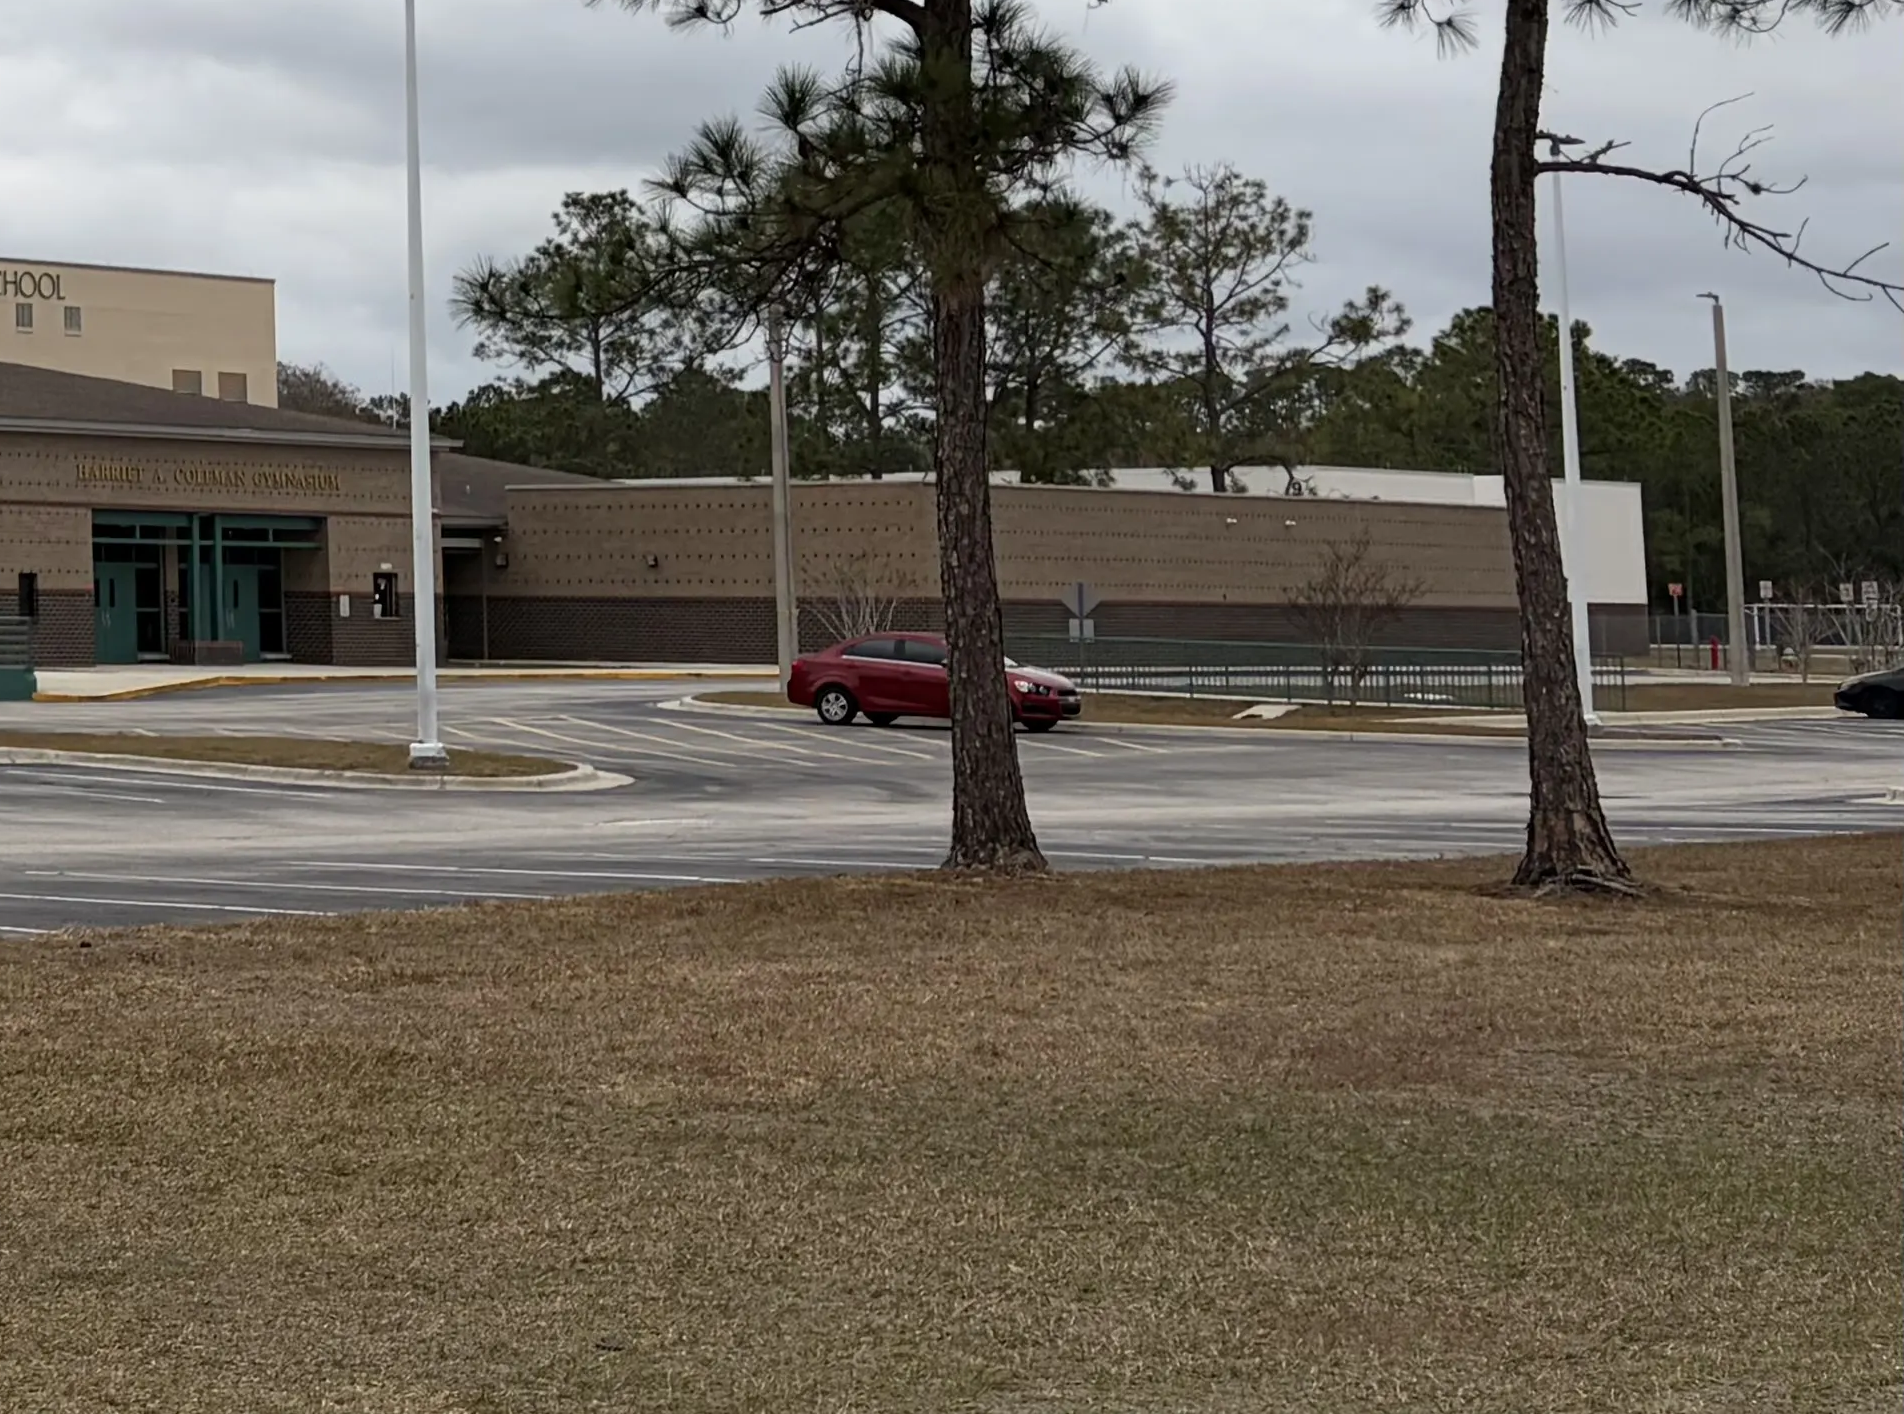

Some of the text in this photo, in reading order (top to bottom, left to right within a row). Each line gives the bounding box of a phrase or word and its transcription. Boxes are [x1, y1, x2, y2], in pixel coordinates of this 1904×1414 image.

[76, 464, 145, 483] HARRIET
[174, 467, 245, 487] COLEMAN
[252, 470, 340, 491] GYMNASIUM
